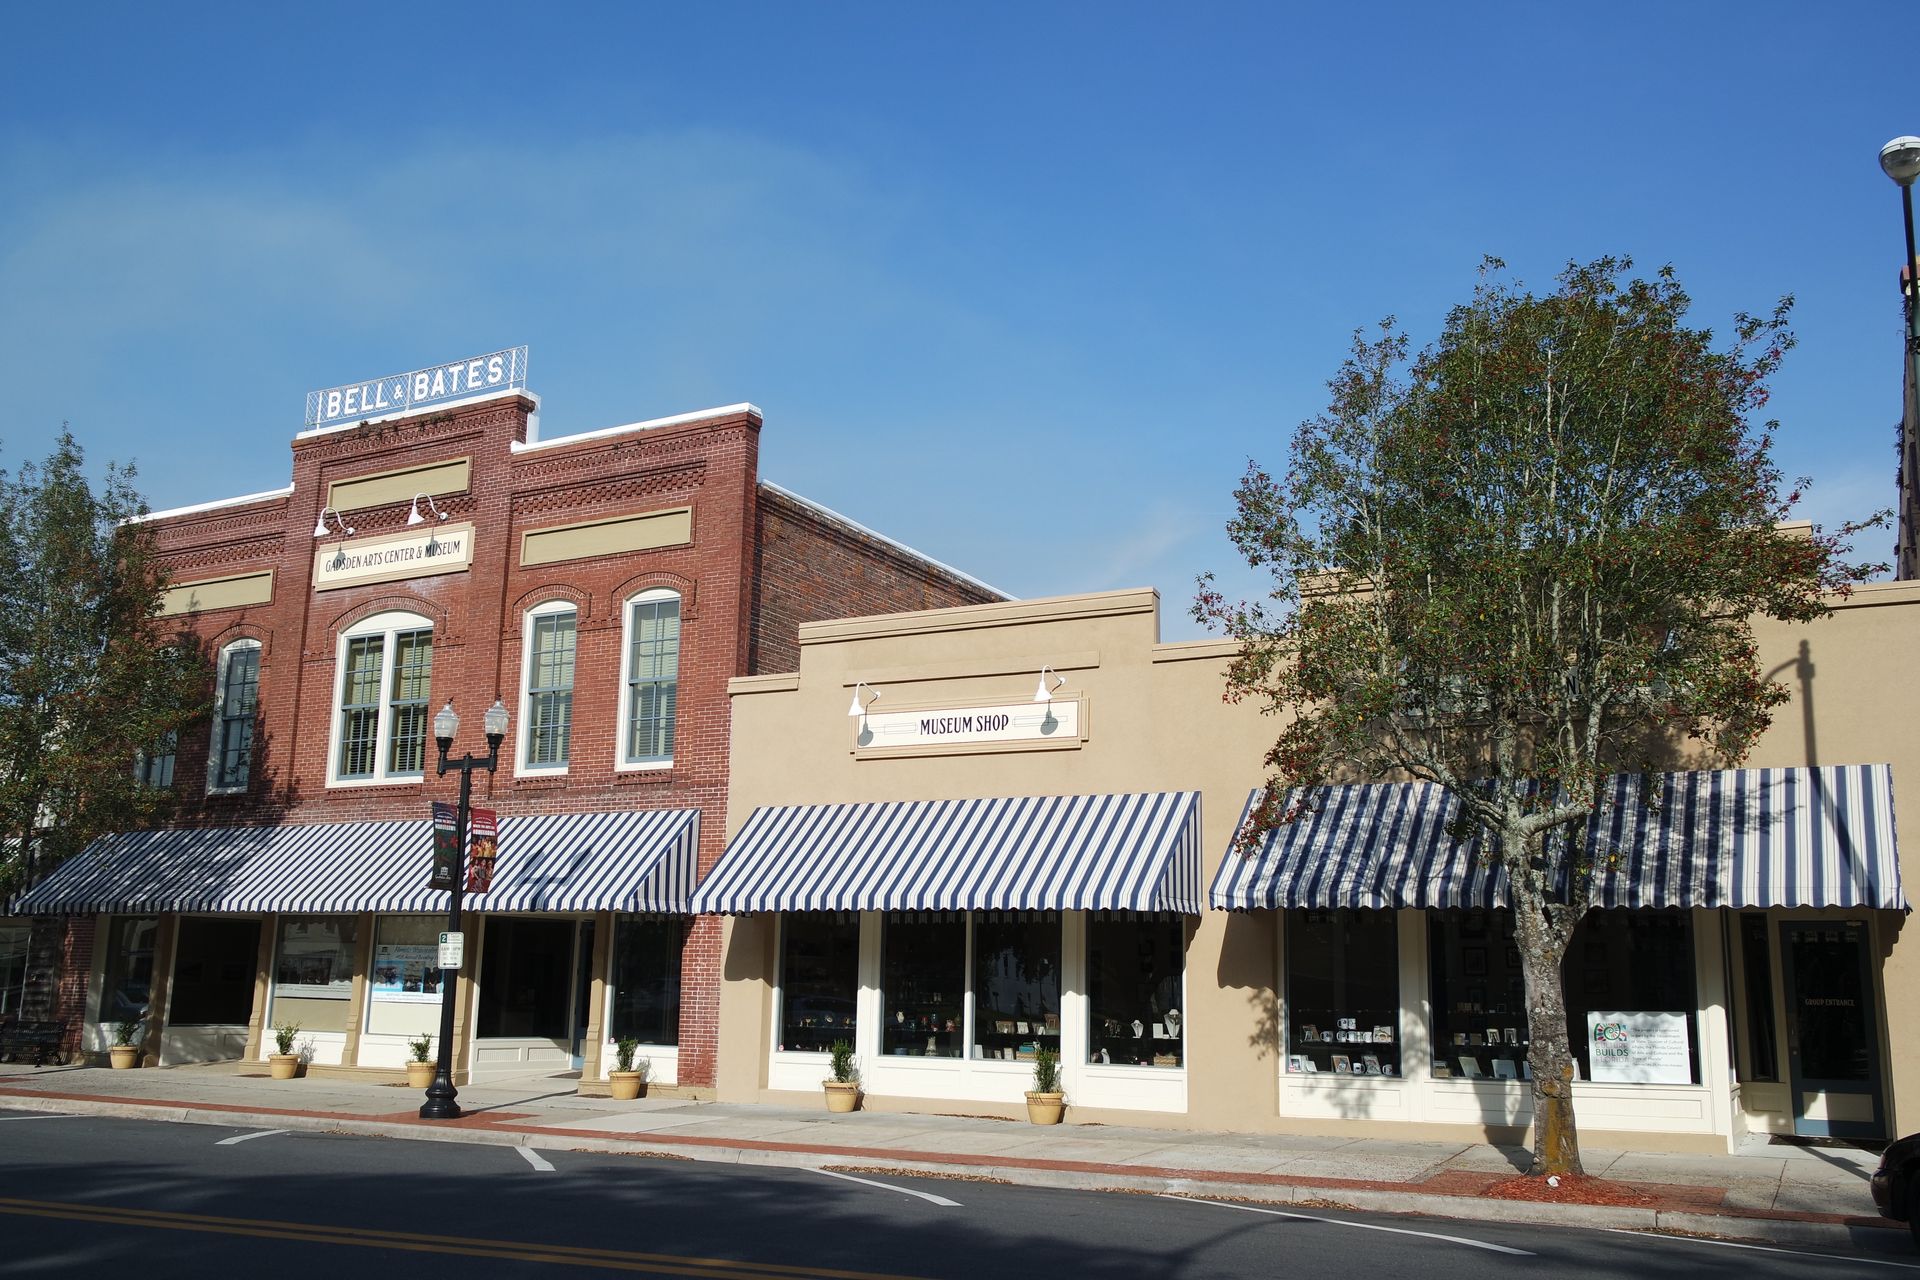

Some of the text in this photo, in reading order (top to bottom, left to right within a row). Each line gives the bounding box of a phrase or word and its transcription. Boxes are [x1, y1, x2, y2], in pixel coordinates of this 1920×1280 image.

[326, 356, 503, 418] BELL & BATES
[325, 540, 461, 573] GADSDEN ARTS CENTER & MUSEUM
[920, 714, 1009, 735] MUSEUM SHOP
[441, 935, 447, 943] 2
[1804, 998, 1855, 1007] GROUP ENTRANCE
[1595, 1048, 1629, 1057] BUILDS
